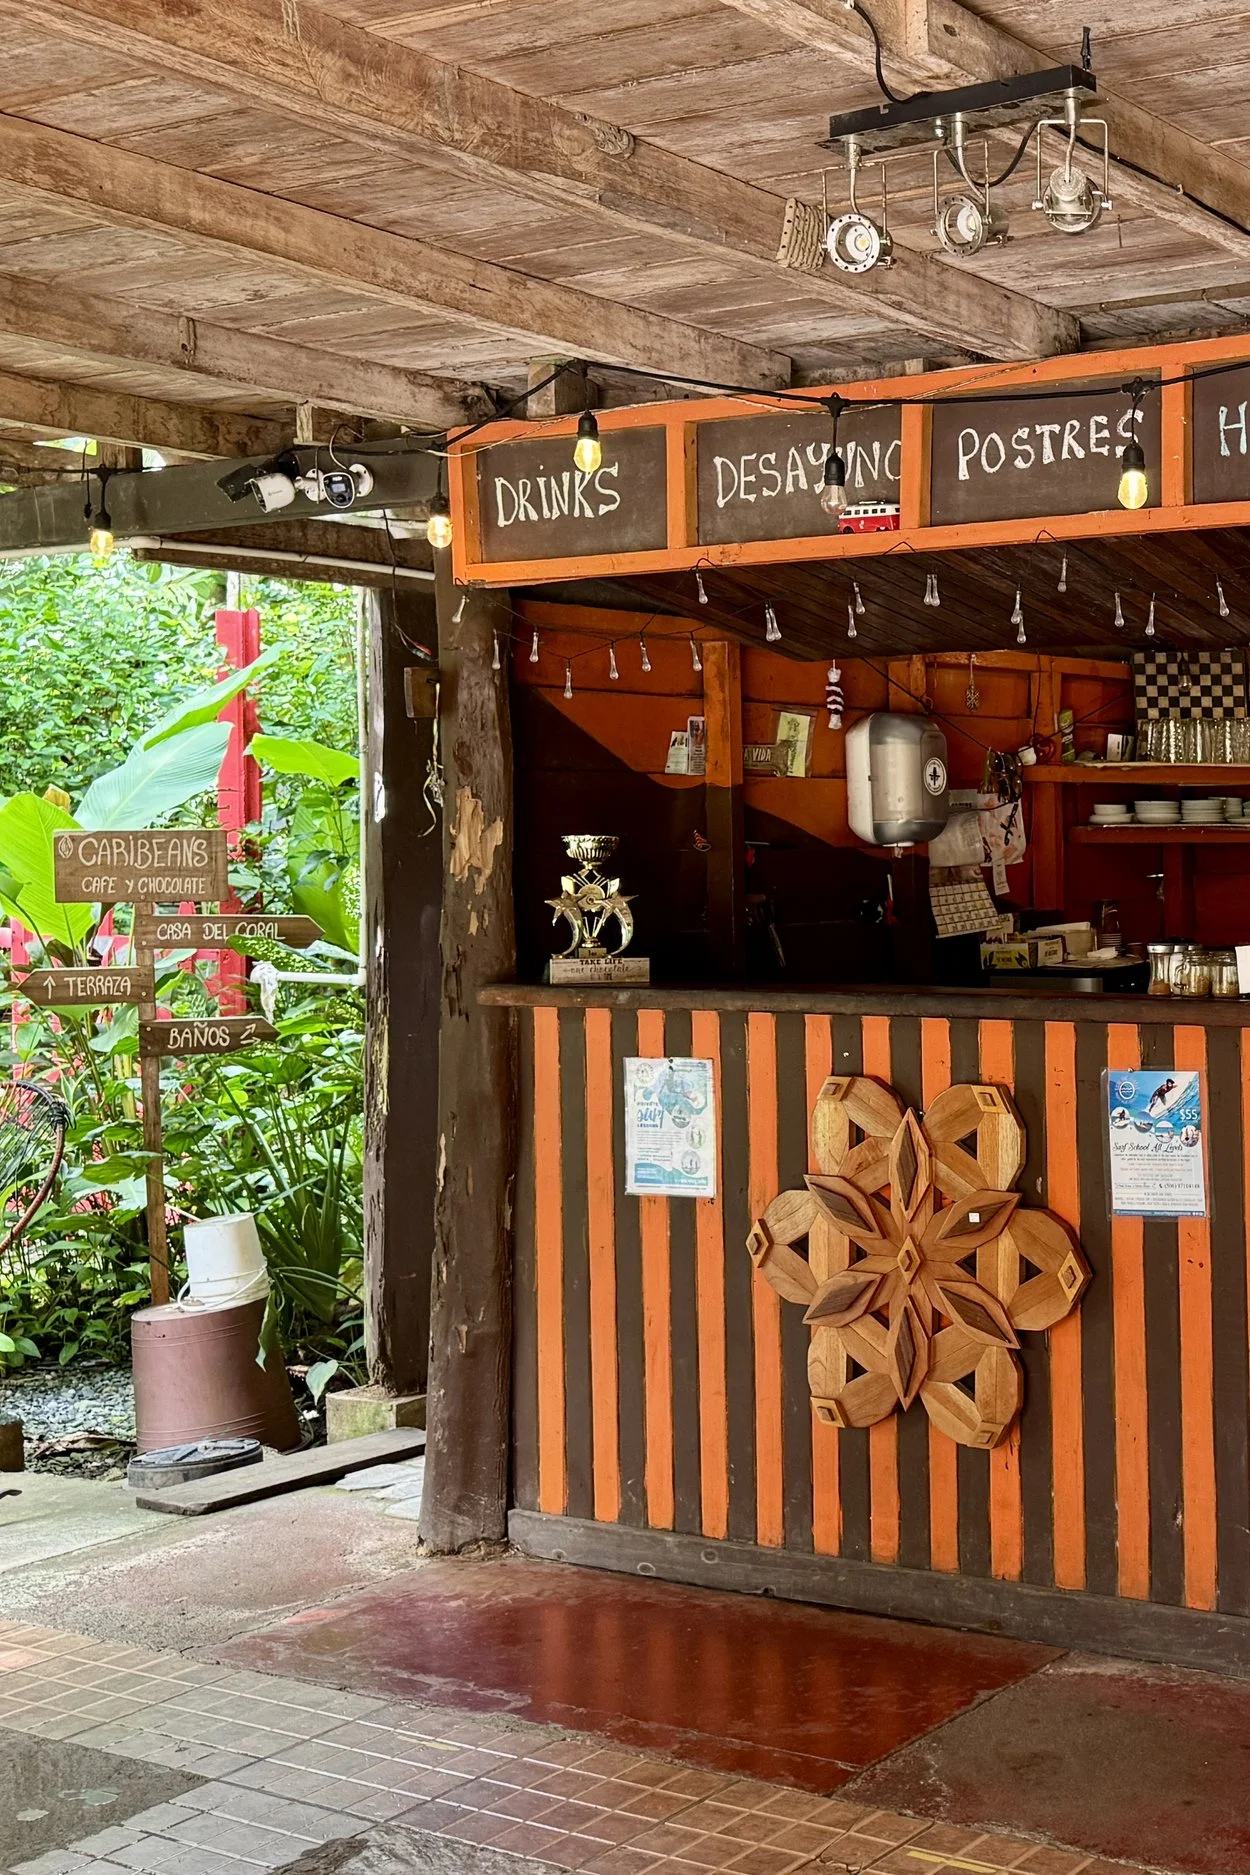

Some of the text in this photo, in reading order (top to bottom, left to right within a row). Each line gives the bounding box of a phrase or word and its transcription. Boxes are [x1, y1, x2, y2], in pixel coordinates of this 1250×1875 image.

[958, 408, 1144, 481] POSTRES
[494, 462, 621, 528] DRINKS
[78, 834, 209, 869] CARIBEANS
[82, 877, 116, 894] CAFE
[137, 876, 206, 894] CHOCOLATE
[157, 921, 286, 940] CASA DEL CORAL
[64, 976, 131, 997] TERRAZA
[168, 1022, 230, 1050] BAÑOS
[1113, 1142, 1127, 1152] Surf
[1128, 1142, 1151, 1152] School
